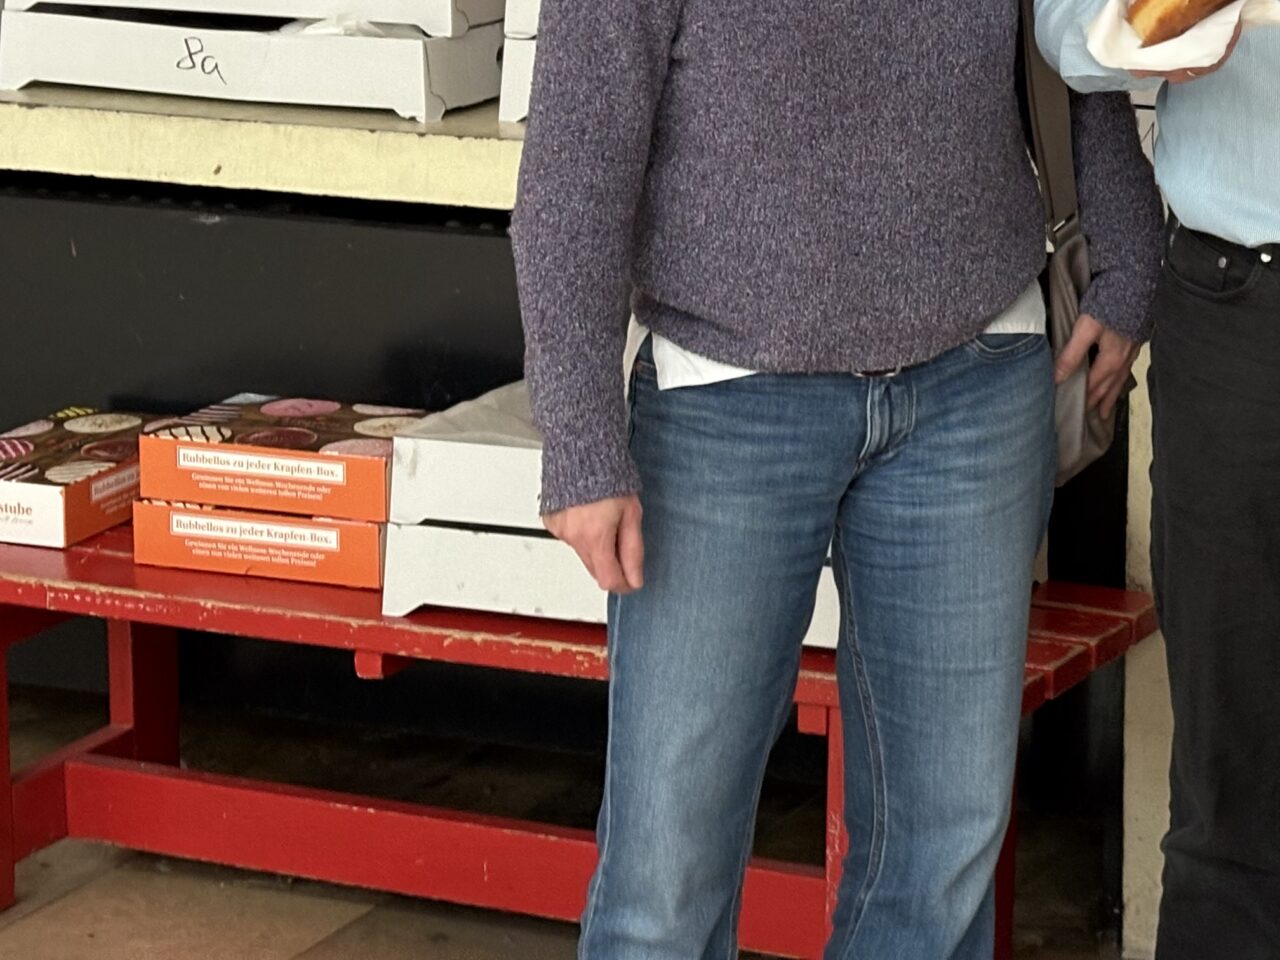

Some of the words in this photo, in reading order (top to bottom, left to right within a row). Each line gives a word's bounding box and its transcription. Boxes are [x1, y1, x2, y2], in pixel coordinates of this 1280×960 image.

[176, 36, 227, 85] 8a
[182, 453, 231, 466] Rubbellos
[233, 459, 244, 469] zu
[245, 459, 271, 471] jeder
[175, 519, 224, 533] Rubbellos
[226, 526, 237, 535] zu
[238, 524, 264, 537] jeder
